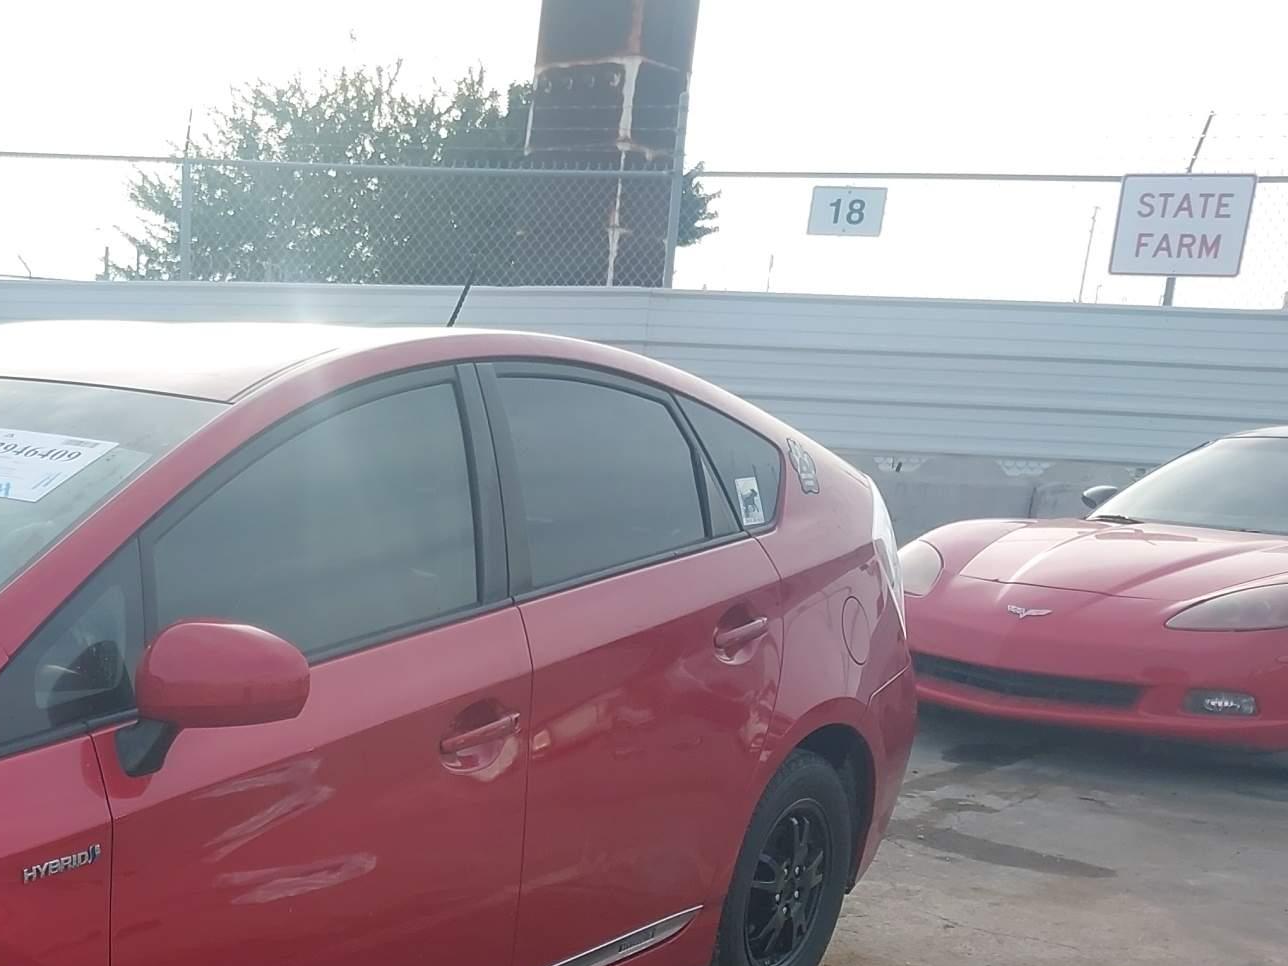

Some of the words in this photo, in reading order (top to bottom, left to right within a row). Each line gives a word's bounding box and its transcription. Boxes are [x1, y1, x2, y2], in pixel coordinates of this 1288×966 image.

[828, 198, 866, 226] 18
[1136, 192, 1235, 220] STATE
[1134, 232, 1223, 260] FARM
[23, 850, 90, 884] HYBRID
